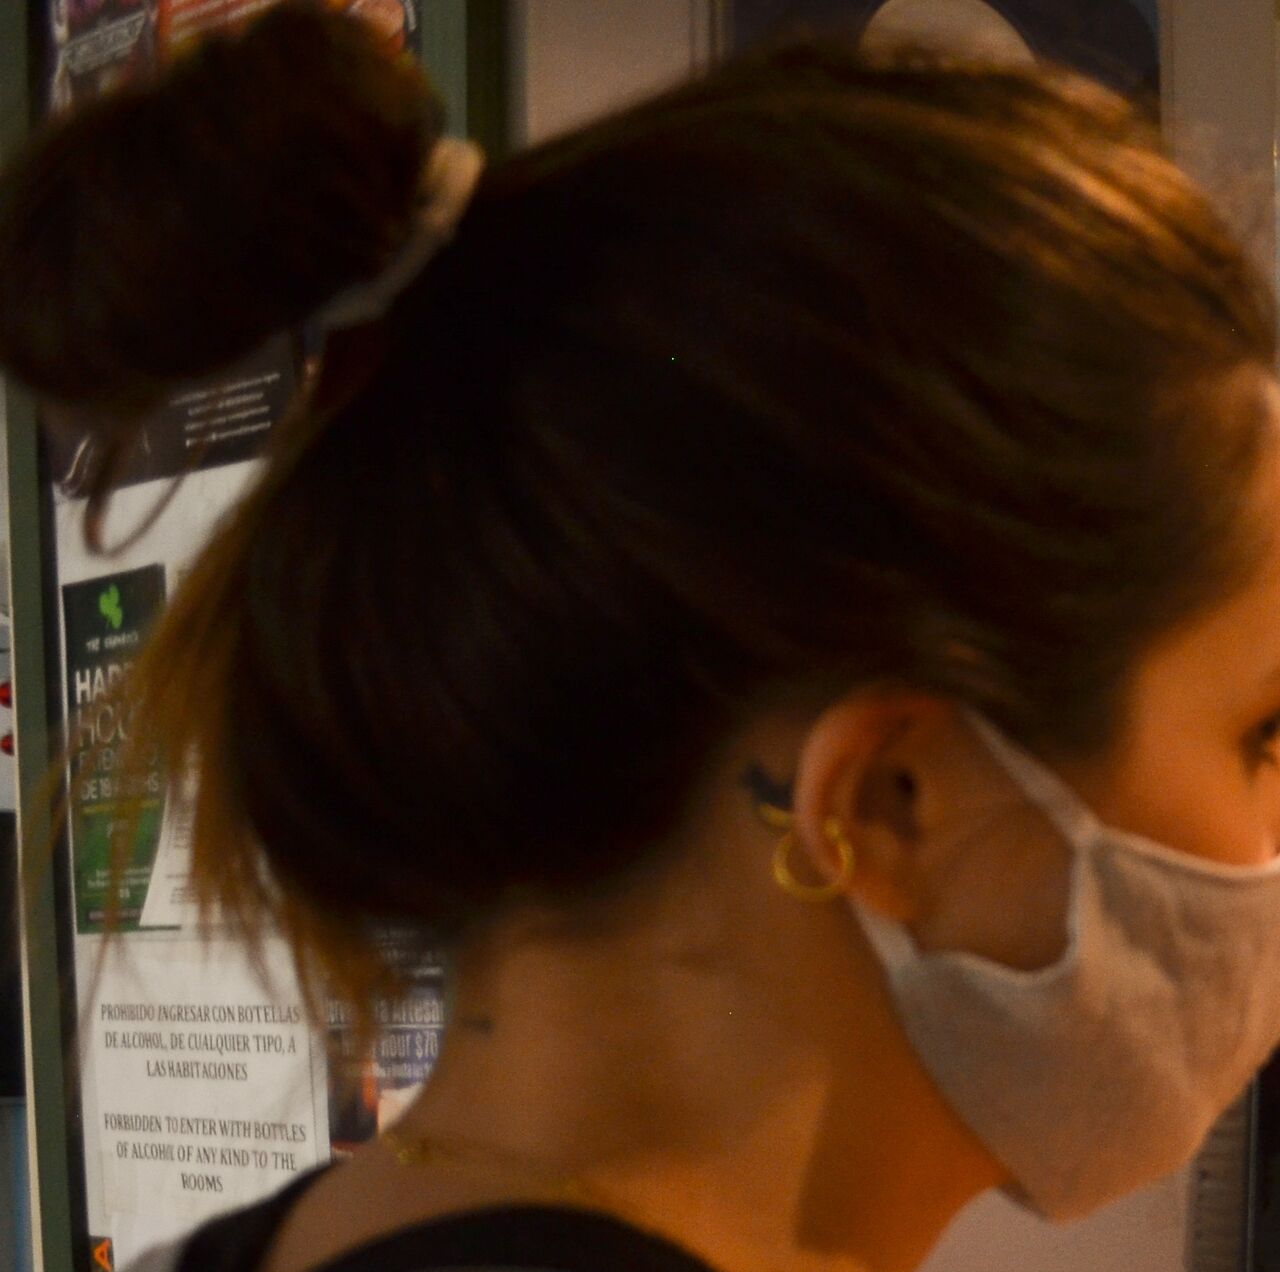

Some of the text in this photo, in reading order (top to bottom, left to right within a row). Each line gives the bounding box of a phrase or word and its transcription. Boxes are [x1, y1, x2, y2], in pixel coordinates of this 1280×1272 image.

[101, 1004, 300, 1025] PROHIBIDO INGRESAR CON BOTELLAS
[105, 1032, 120, 1048] DE
[170, 1033, 185, 1050] DE
[188, 1033, 250, 1056] CUALQUIER
[253, 1034, 285, 1055] TIPO,
[288, 1036, 296, 1054] A
[147, 1060, 248, 1081] LAS HABITACIONES
[104, 1113, 306, 1142] FORBIDDEN TO ENTER WITH BOTTLES
[116, 1141, 130, 1158] OF
[178, 1145, 194, 1162] OF
[196, 1147, 217, 1165] ANY
[220, 1148, 249, 1167] KIND
[252, 1151, 268, 1169] TO
[272, 1151, 296, 1172] THE
[181, 1173, 223, 1193] ROOMS
